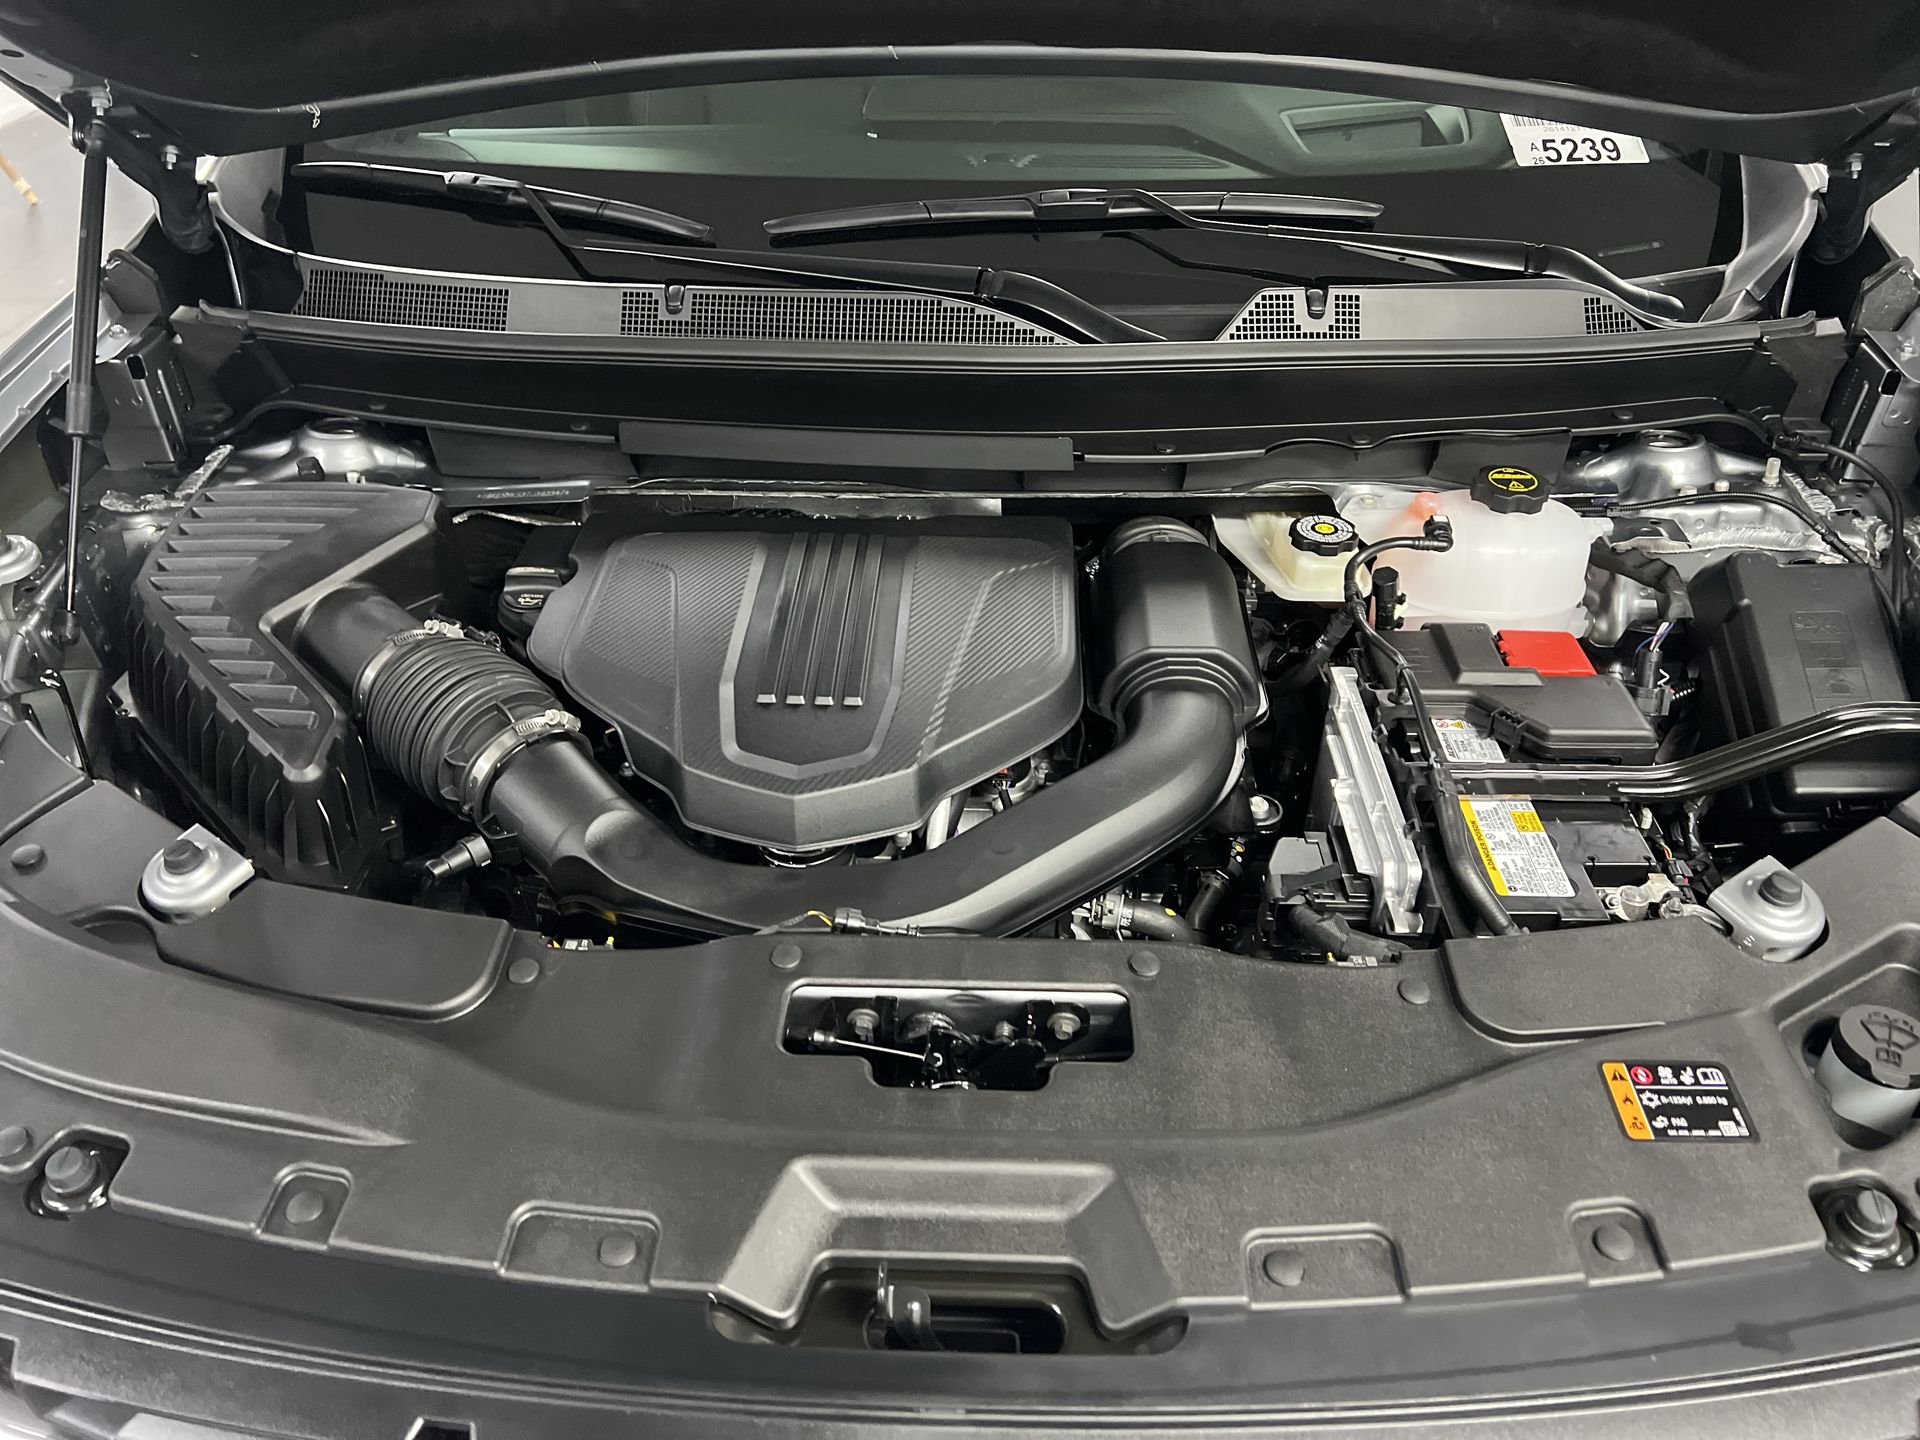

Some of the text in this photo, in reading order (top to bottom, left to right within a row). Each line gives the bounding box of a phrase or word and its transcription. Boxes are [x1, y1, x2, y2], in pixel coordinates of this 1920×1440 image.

[1530, 142, 1539, 152] A
[1541, 137, 1621, 163] 5239
[1532, 157, 1545, 165] 26
